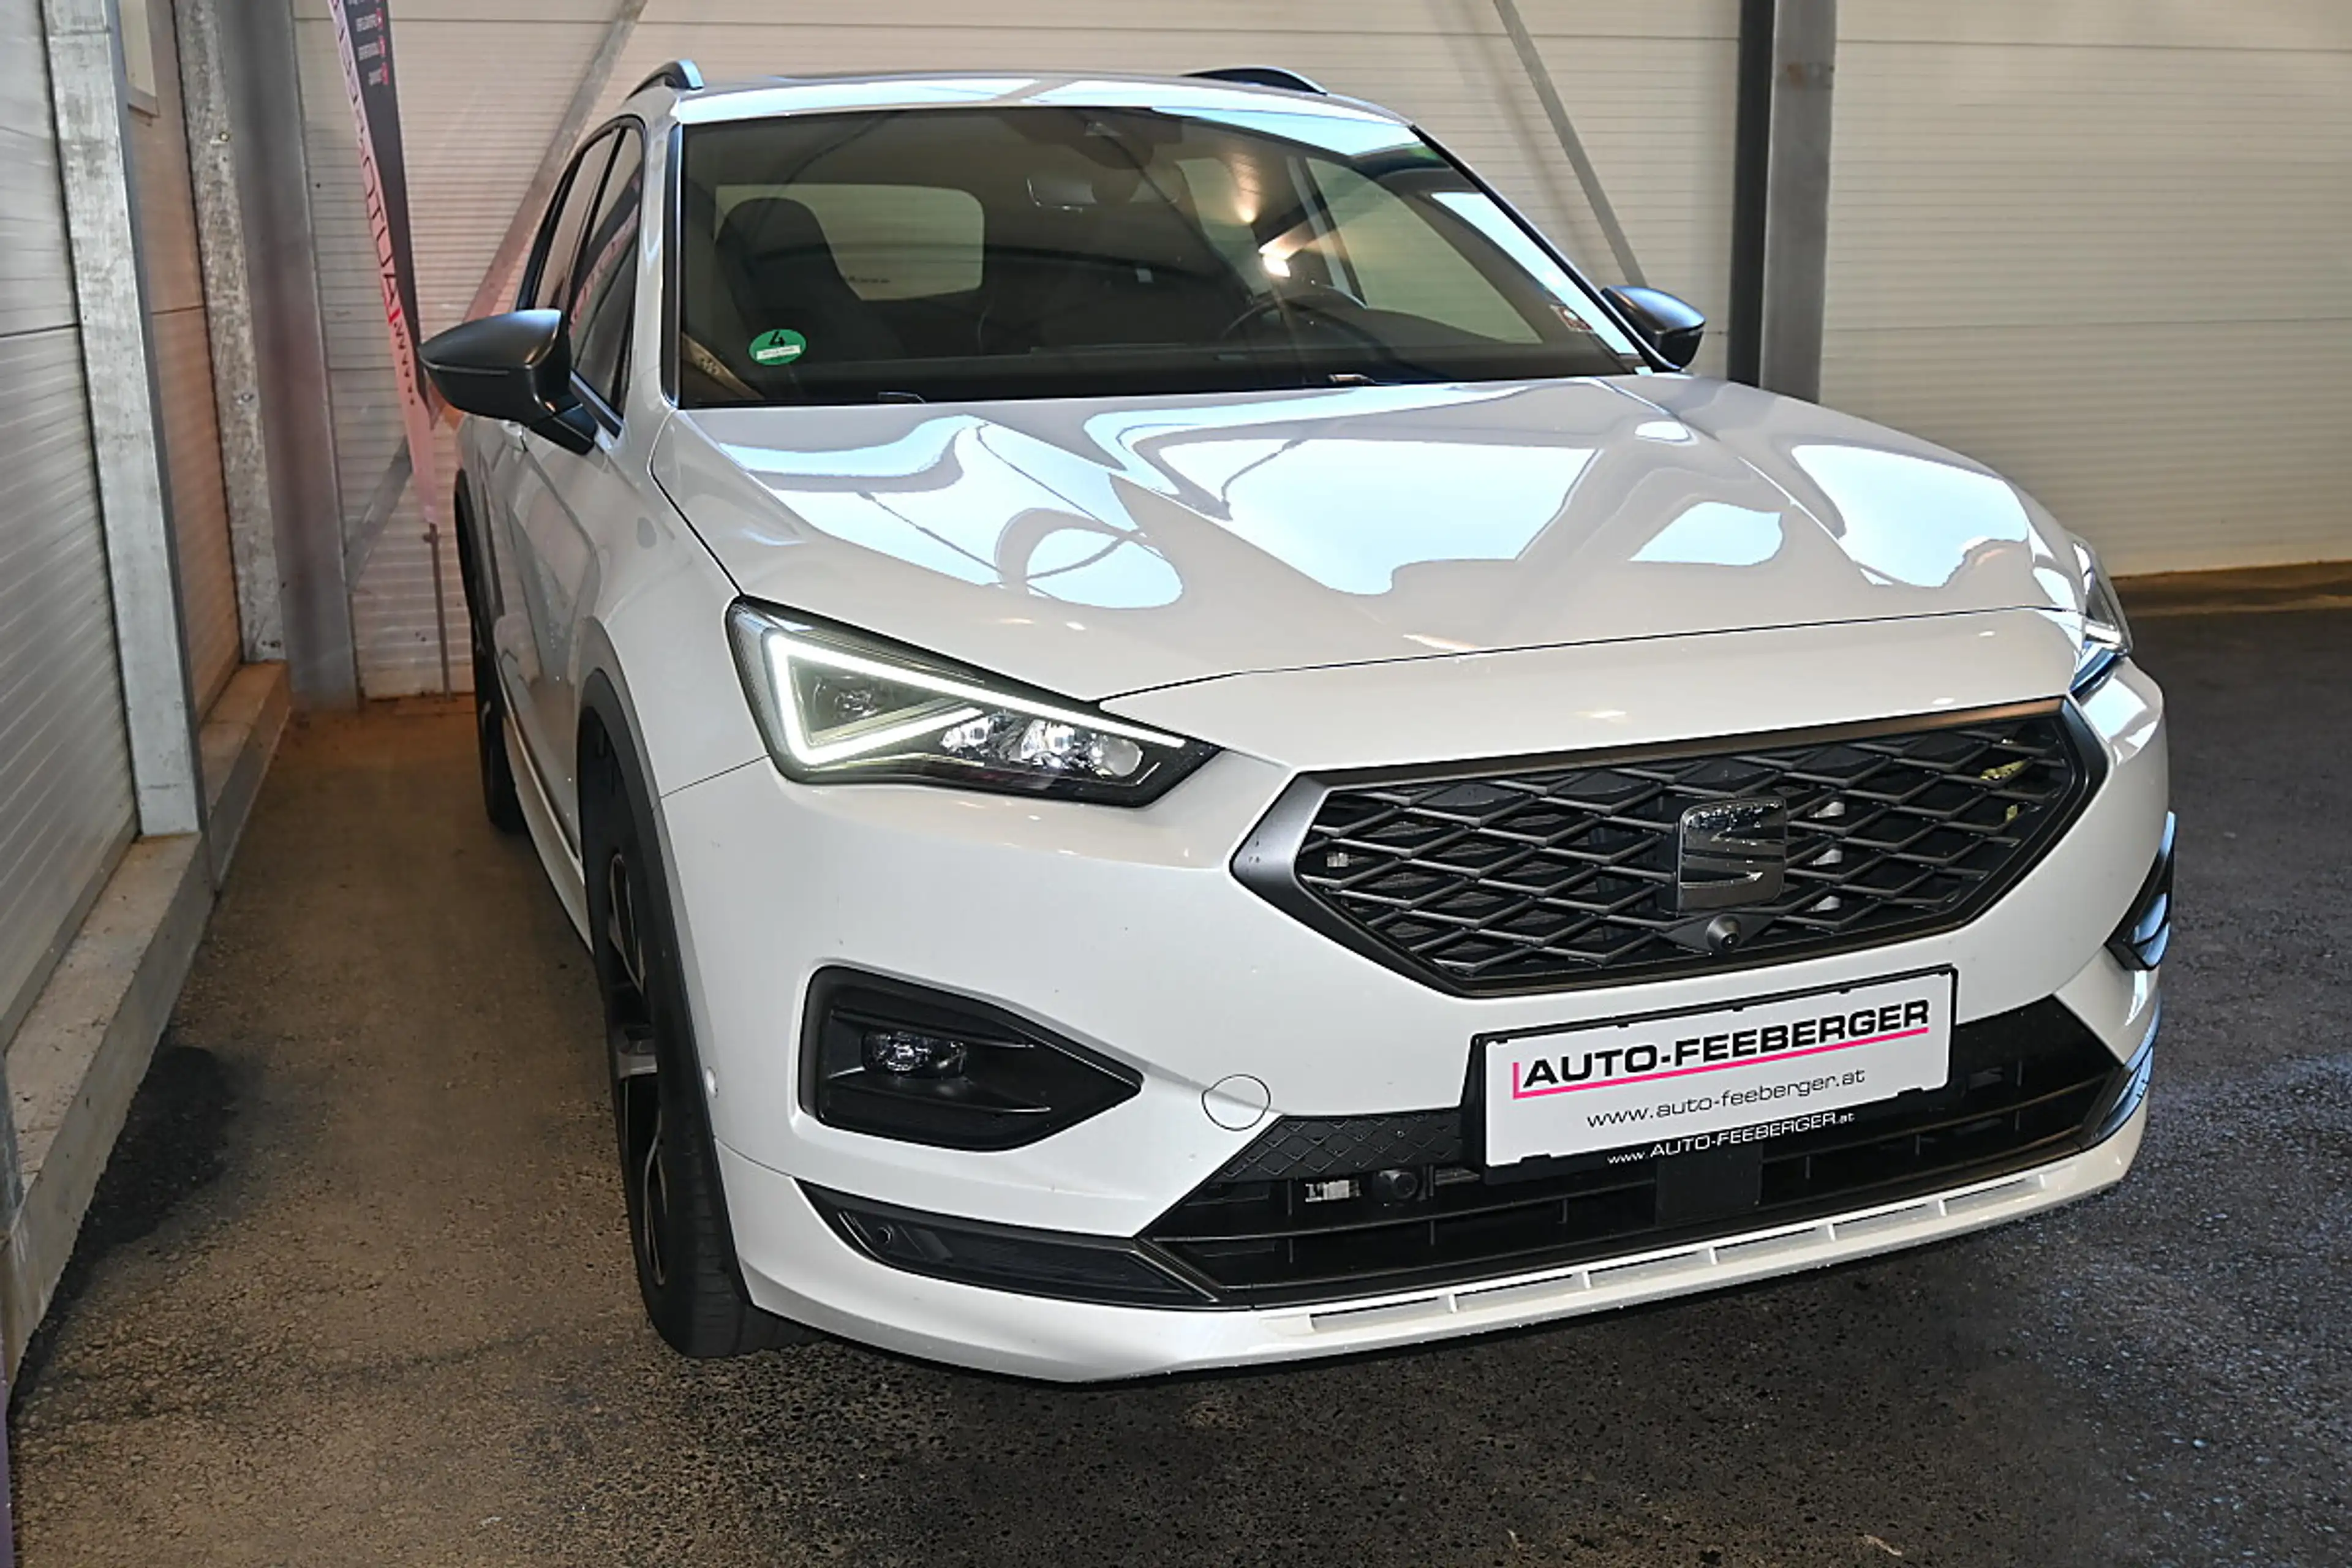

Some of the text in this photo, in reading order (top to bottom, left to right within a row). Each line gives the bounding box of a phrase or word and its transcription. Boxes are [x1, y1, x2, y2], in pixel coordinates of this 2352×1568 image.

[769, 331, 785, 346] 4
[1523, 1000, 1929, 1088] AUTO-FEEBERGER
[1586, 1069, 1866, 1128] www.auto-feeberger.at
[1607, 1113, 1855, 1164] www.AUTO-FEEBERGER.at
